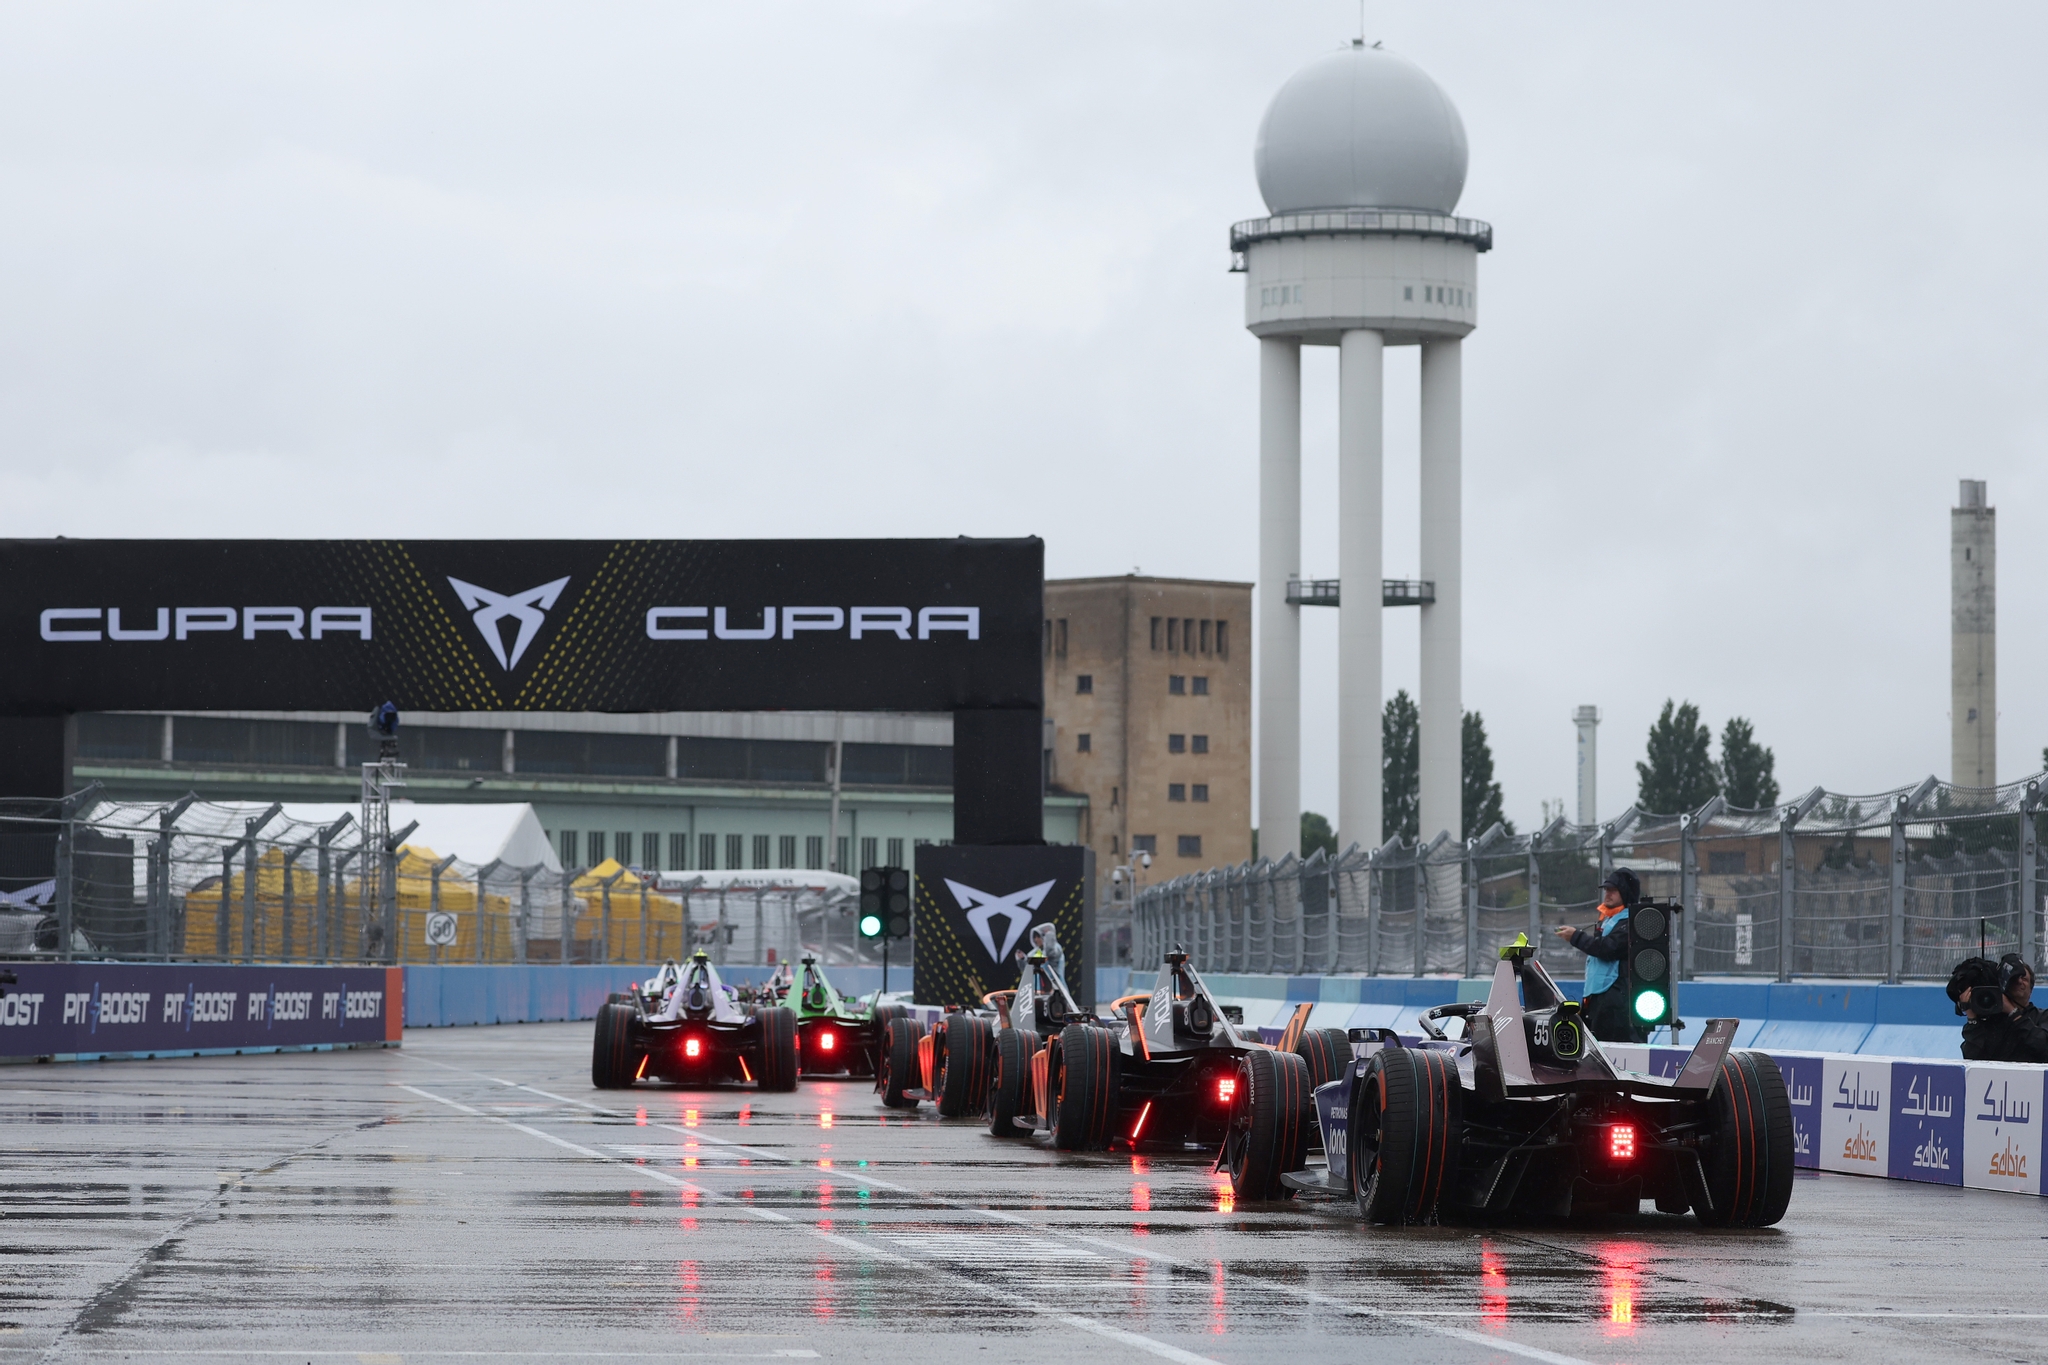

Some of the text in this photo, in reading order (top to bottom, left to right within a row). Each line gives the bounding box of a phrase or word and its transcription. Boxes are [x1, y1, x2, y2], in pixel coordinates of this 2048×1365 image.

[40, 606, 372, 642] CUPRA
[646, 606, 980, 640] CUPRA
[0, 993, 45, 1026] OST
[63, 992, 151, 1024] PIT BOOST
[163, 992, 237, 1023] PIT BOOST
[248, 992, 313, 1021] PIT BOOST
[322, 991, 382, 1020] PIT BOOST
[1019, 988, 1033, 1024] TDK
[1154, 991, 1171, 1035] TDK
[1533, 1019, 1549, 1046] 55
[1705, 1036, 1726, 1045] BIANCHET
[1330, 1106, 1348, 1119] PETRONAS
[1832, 1070, 1880, 1123] سابك
[1901, 1074, 1953, 1129] سابك
[1976, 1080, 2030, 1137] سابك
[1793, 1116, 1810, 1154] bic
[1843, 1123, 1877, 1161] sabic
[1913, 1129, 1950, 1170] sabic
[1988, 1135, 2028, 1178] sabic
